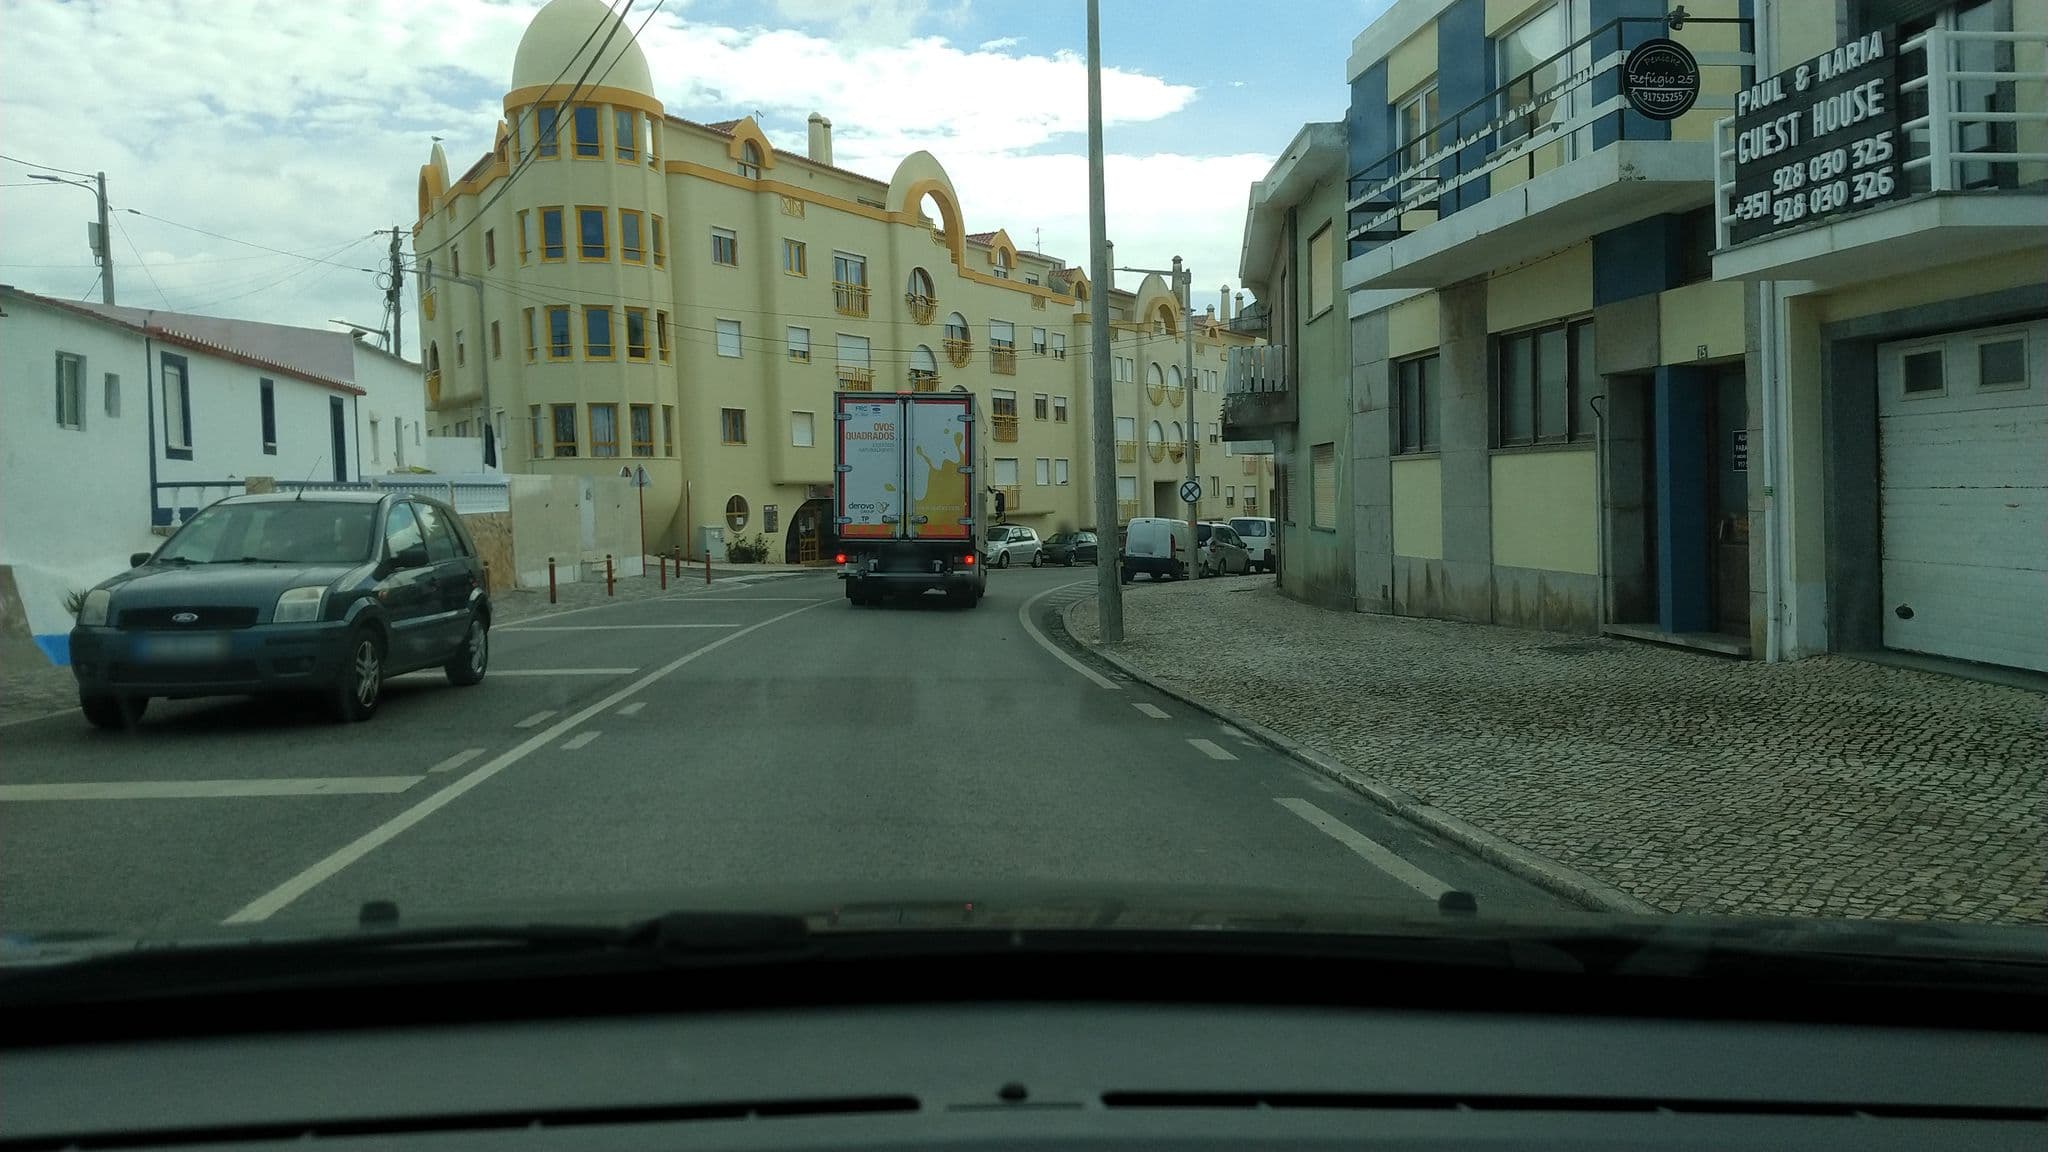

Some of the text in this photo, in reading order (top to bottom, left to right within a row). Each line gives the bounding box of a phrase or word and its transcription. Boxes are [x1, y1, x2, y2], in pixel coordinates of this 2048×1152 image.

[1677, 74, 1696, 84] 25
[1738, 31, 1884, 117] PAUL & MARIA
[1738, 78, 1885, 164] GUEST HOUSE
[1773, 130, 1893, 195] 928 030 325
[1735, 190, 1771, 220] +351
[1773, 165, 1895, 225] 928 030 326
[846, 431, 895, 440] QUADRADOS
[873, 422, 895, 431] OVOS
